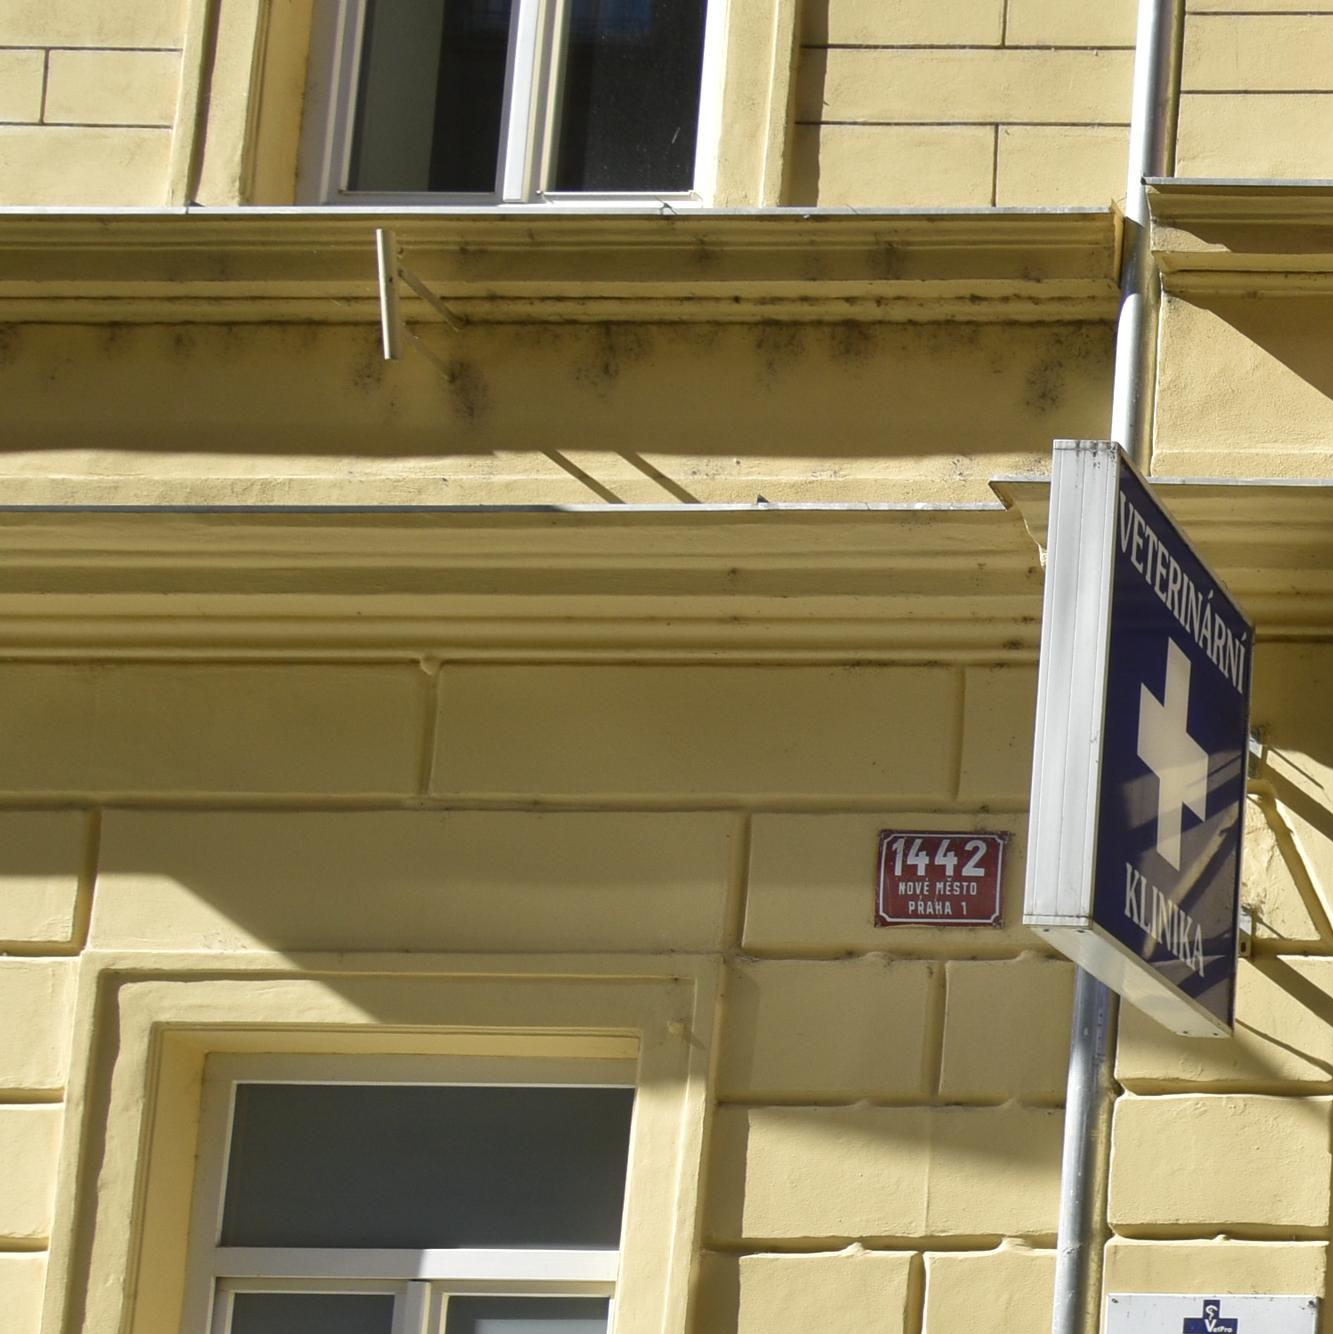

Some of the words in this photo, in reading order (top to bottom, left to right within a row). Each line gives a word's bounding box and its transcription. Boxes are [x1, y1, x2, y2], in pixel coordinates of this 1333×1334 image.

[1119, 490, 1247, 695] VETERINÁRNÍ
[892, 838, 987, 877] 1442
[899, 878, 929, 895] NOVÉ
[936, 877, 977, 895] MĚSTO
[908, 901, 952, 915] PRAHA
[961, 901, 967, 915] 1
[1125, 862, 1205, 977] KLINIKA
